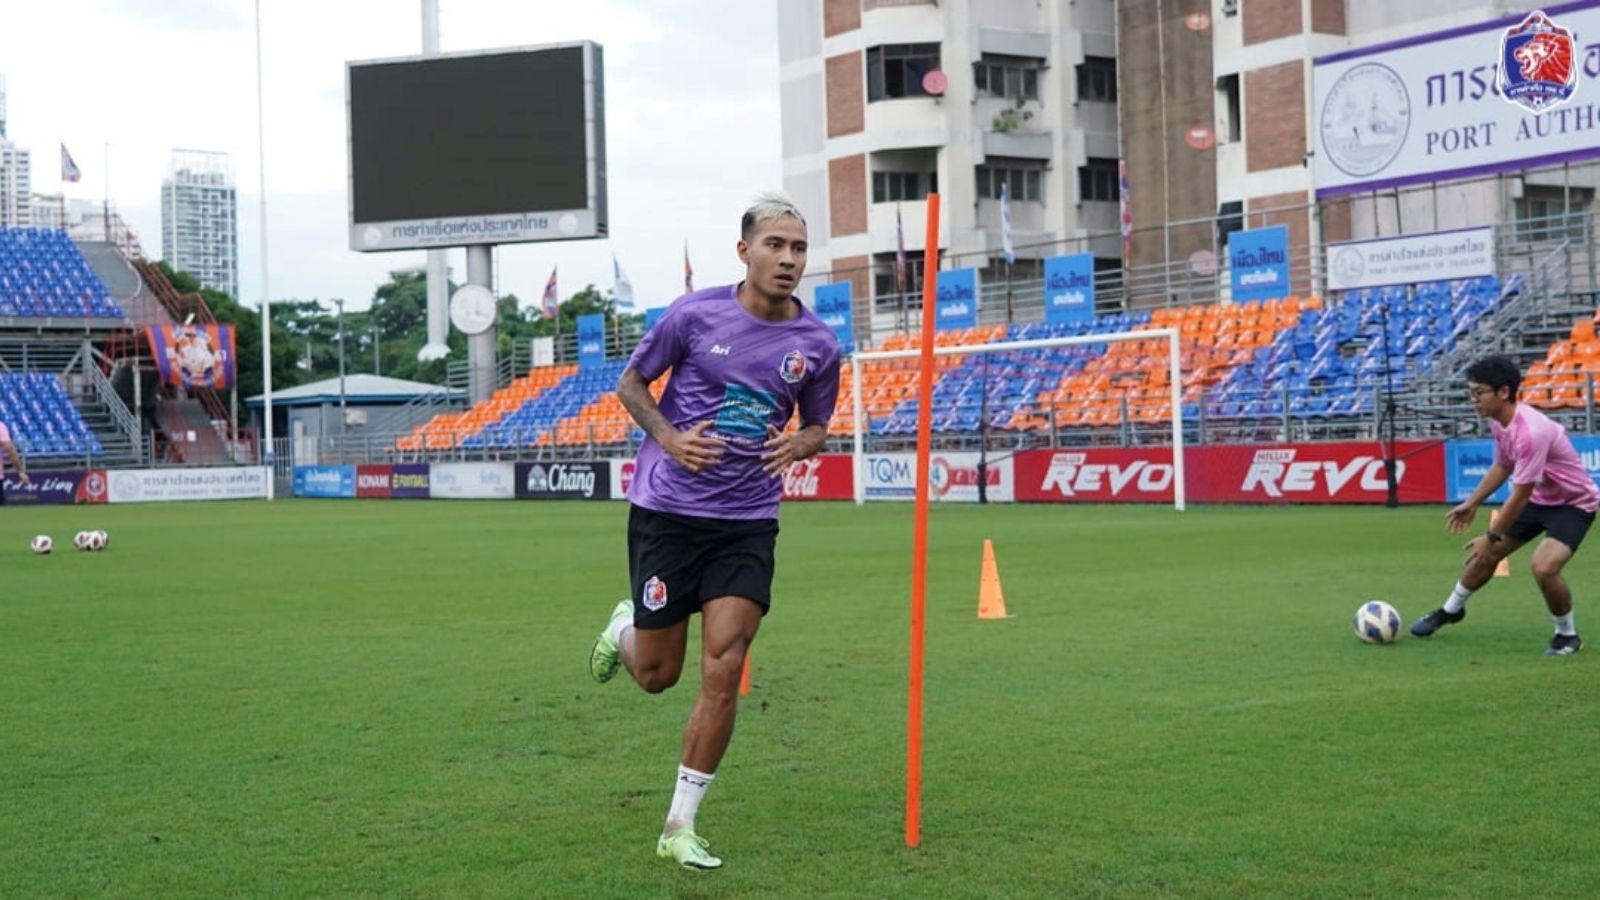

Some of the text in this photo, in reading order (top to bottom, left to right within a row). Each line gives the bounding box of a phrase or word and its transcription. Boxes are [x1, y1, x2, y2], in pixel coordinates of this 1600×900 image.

[1425, 102, 1600, 156] PORT AUTH
[711, 344, 731, 355] Ari
[549, 463, 596, 498] Chang
[867, 457, 912, 484] TQM
[1041, 460, 1174, 496] REVO
[1241, 456, 1406, 497] REVO
